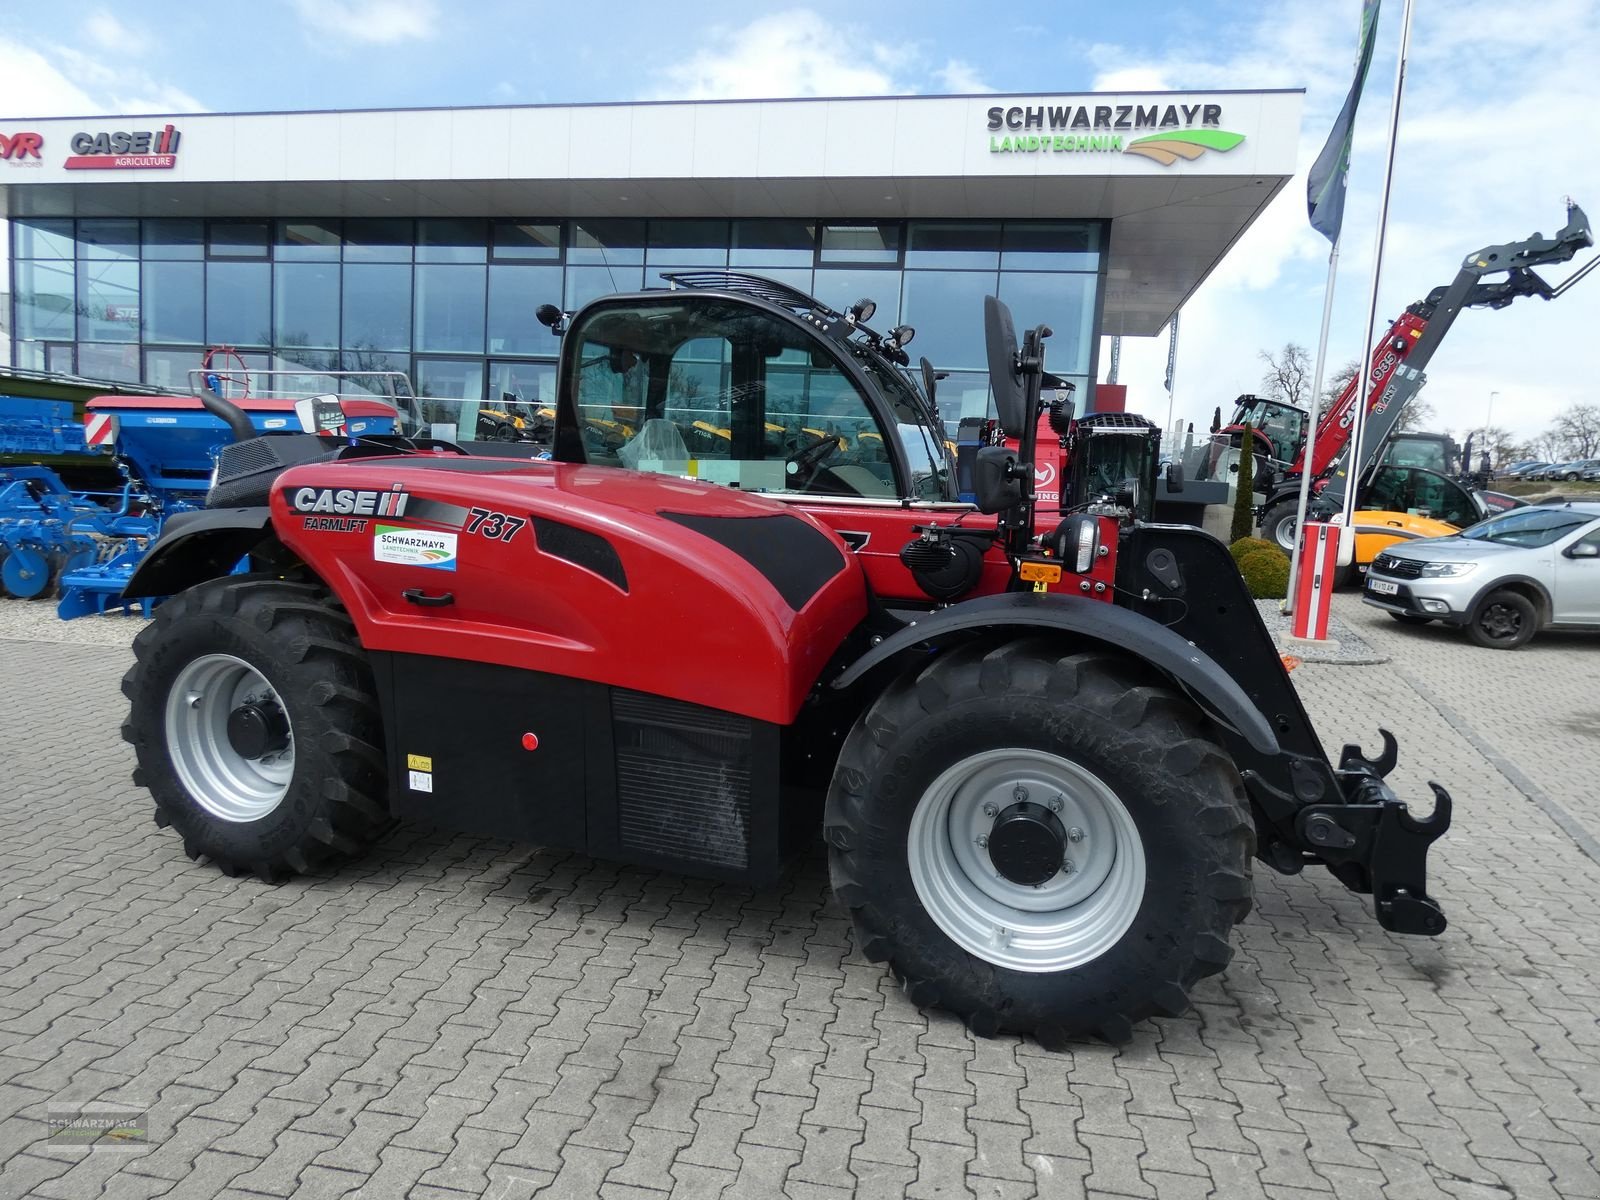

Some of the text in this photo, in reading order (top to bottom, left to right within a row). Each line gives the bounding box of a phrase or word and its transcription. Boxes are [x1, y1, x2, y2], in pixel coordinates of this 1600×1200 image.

[986, 104, 1222, 131] SCHWARZMAYR
[0, 133, 43, 160] YR
[70, 131, 152, 155] CASE
[989, 135, 1123, 153] LANDTECHNIK
[114, 157, 171, 167] AGRICULTURE
[1372, 351, 1396, 381] 935
[1376, 385, 1396, 414] GIANT
[294, 487, 378, 515] CASE
[1035, 492, 1059, 500] ING
[303, 516, 368, 533] FARMLIFT
[467, 506, 527, 543] 737
[381, 534, 446, 549] SCHWARZMAYR
[382, 544, 419, 557] LANDTECHNIK
